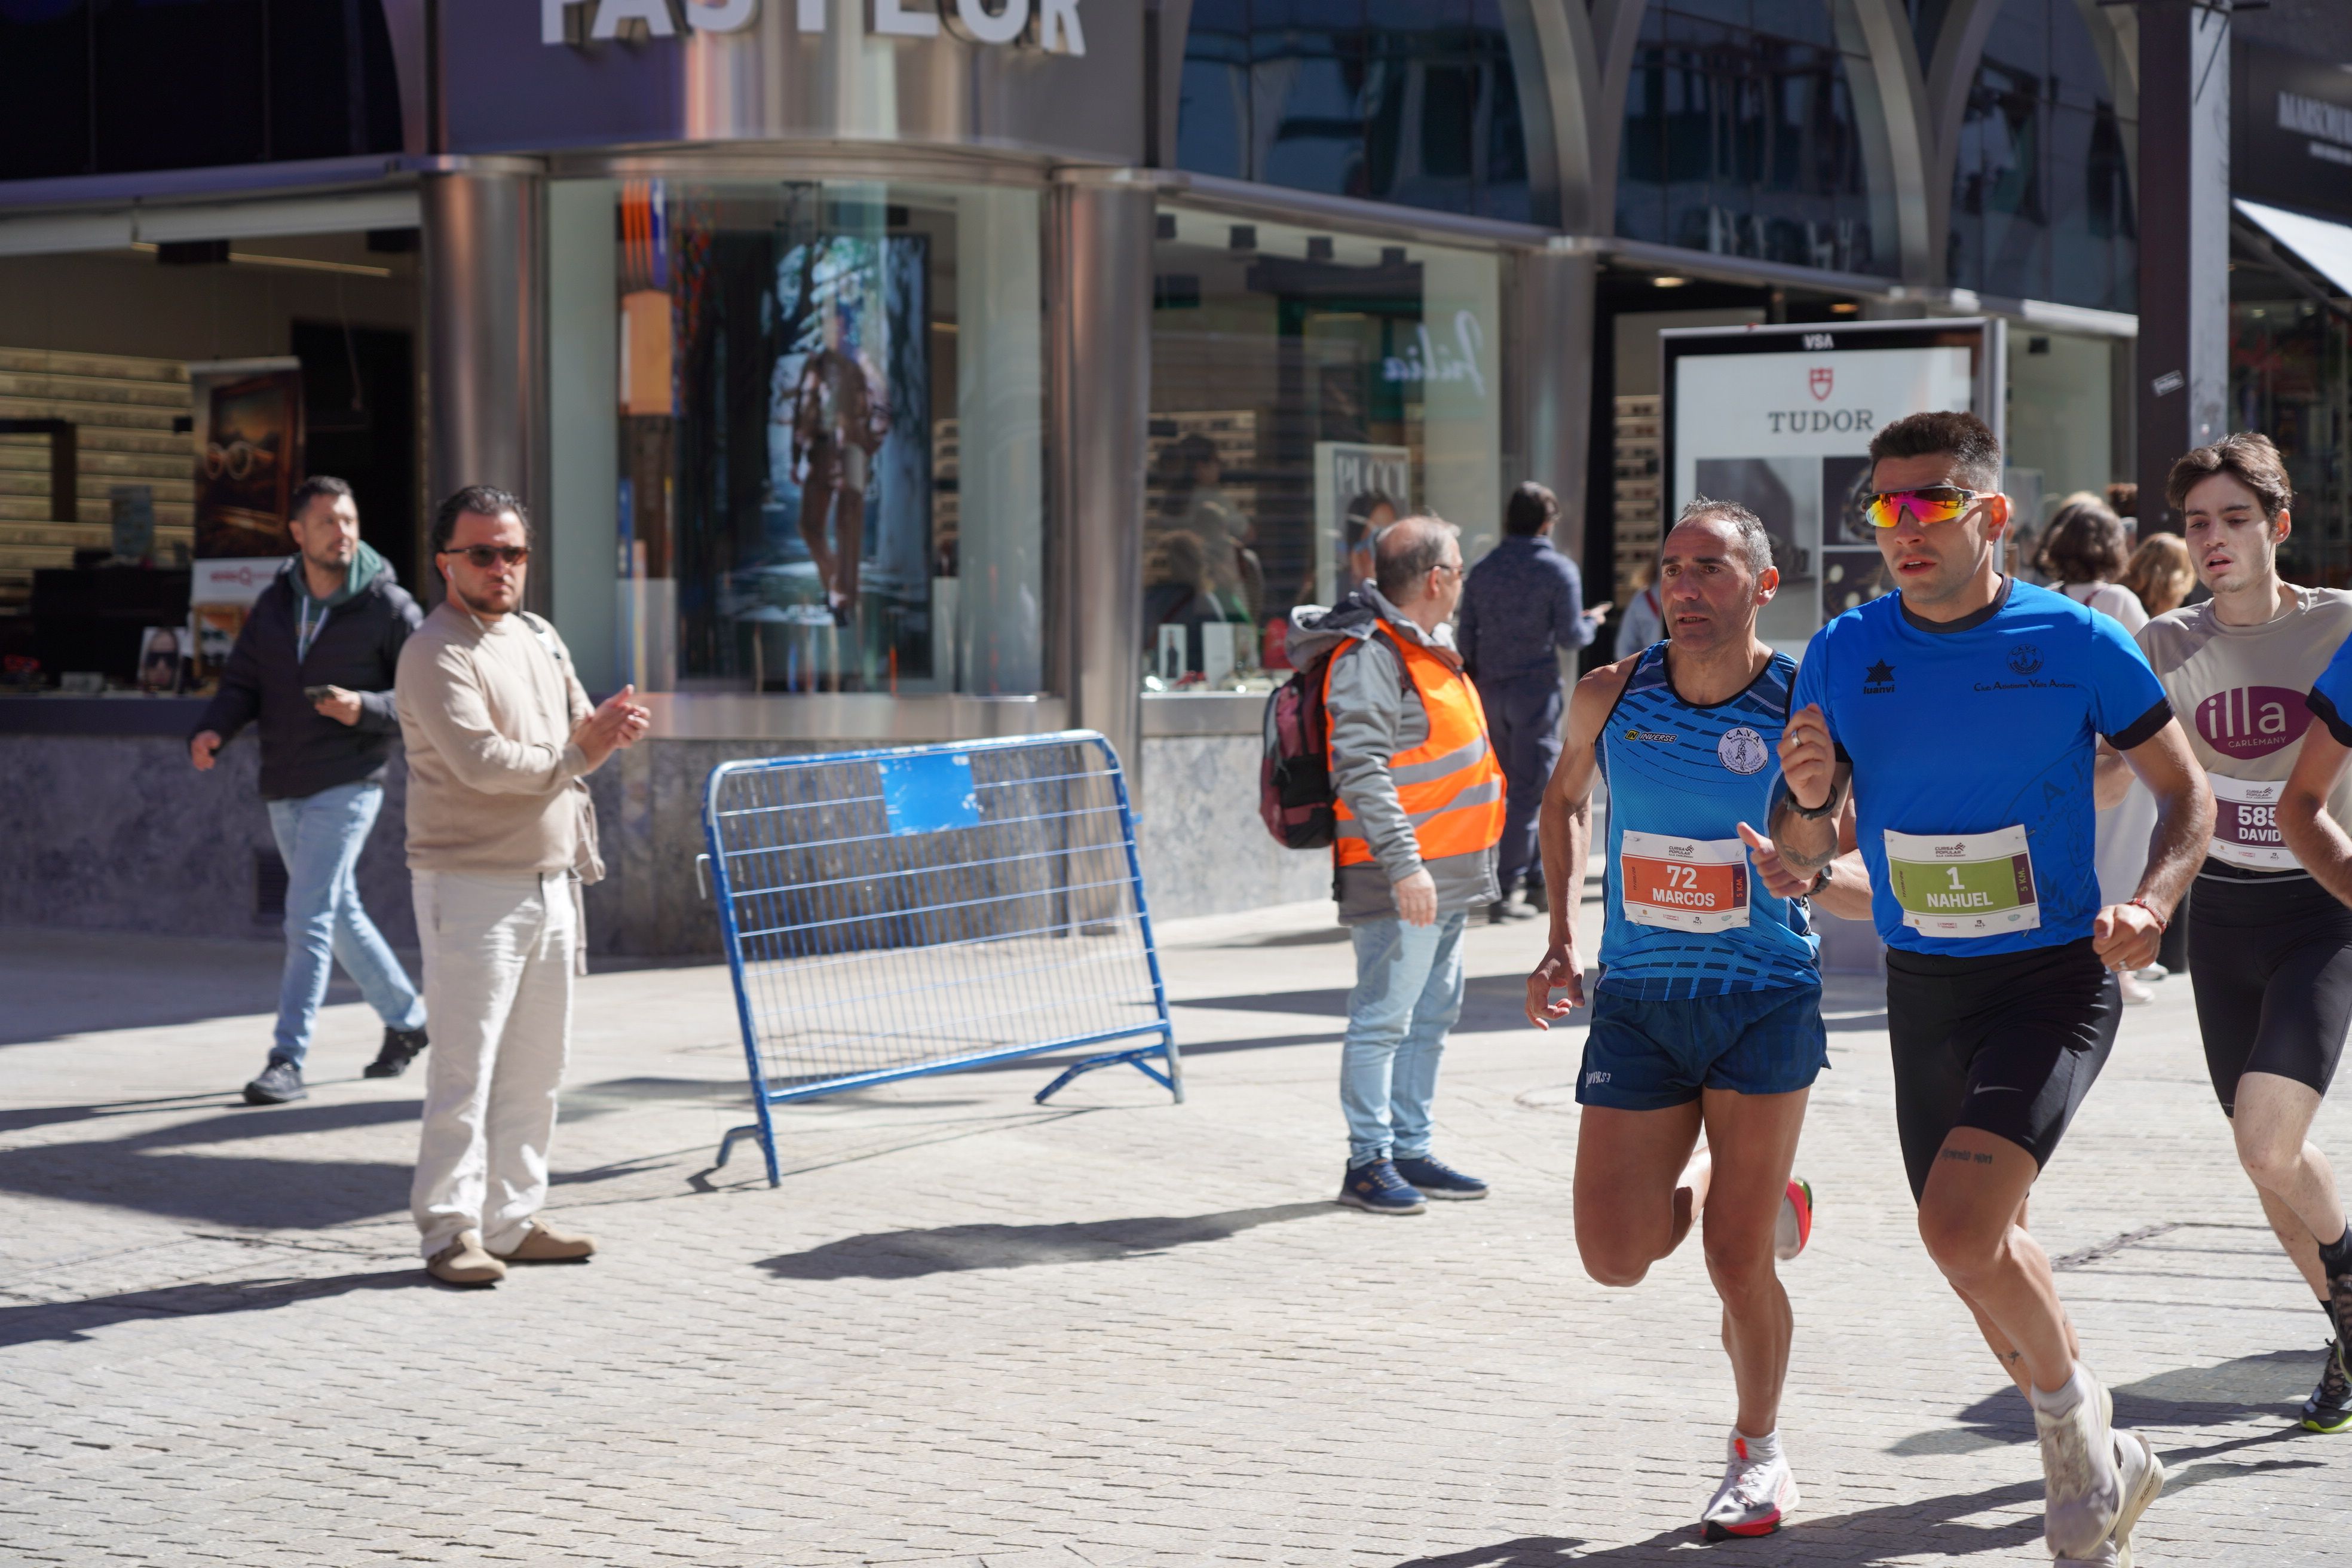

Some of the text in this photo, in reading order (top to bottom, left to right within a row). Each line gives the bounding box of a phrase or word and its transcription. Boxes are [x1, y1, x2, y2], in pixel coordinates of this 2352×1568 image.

[1767, 409, 1874, 434] TUDOR
[1863, 685, 1895, 694] luanvi
[1974, 683, 1991, 691] Club
[2208, 687, 2286, 739] illa
[1639, 733, 1677, 743] INVERSE
[2228, 736, 2287, 748] CARLEMANY
[2238, 827, 2282, 842] DAVID
[1667, 865, 1698, 889] 72
[1946, 866, 1965, 890] 1
[2019, 868, 2028, 884] KM.
[1652, 888, 1715, 907] MARCOS
[1927, 892, 1993, 908] NAHUEL
